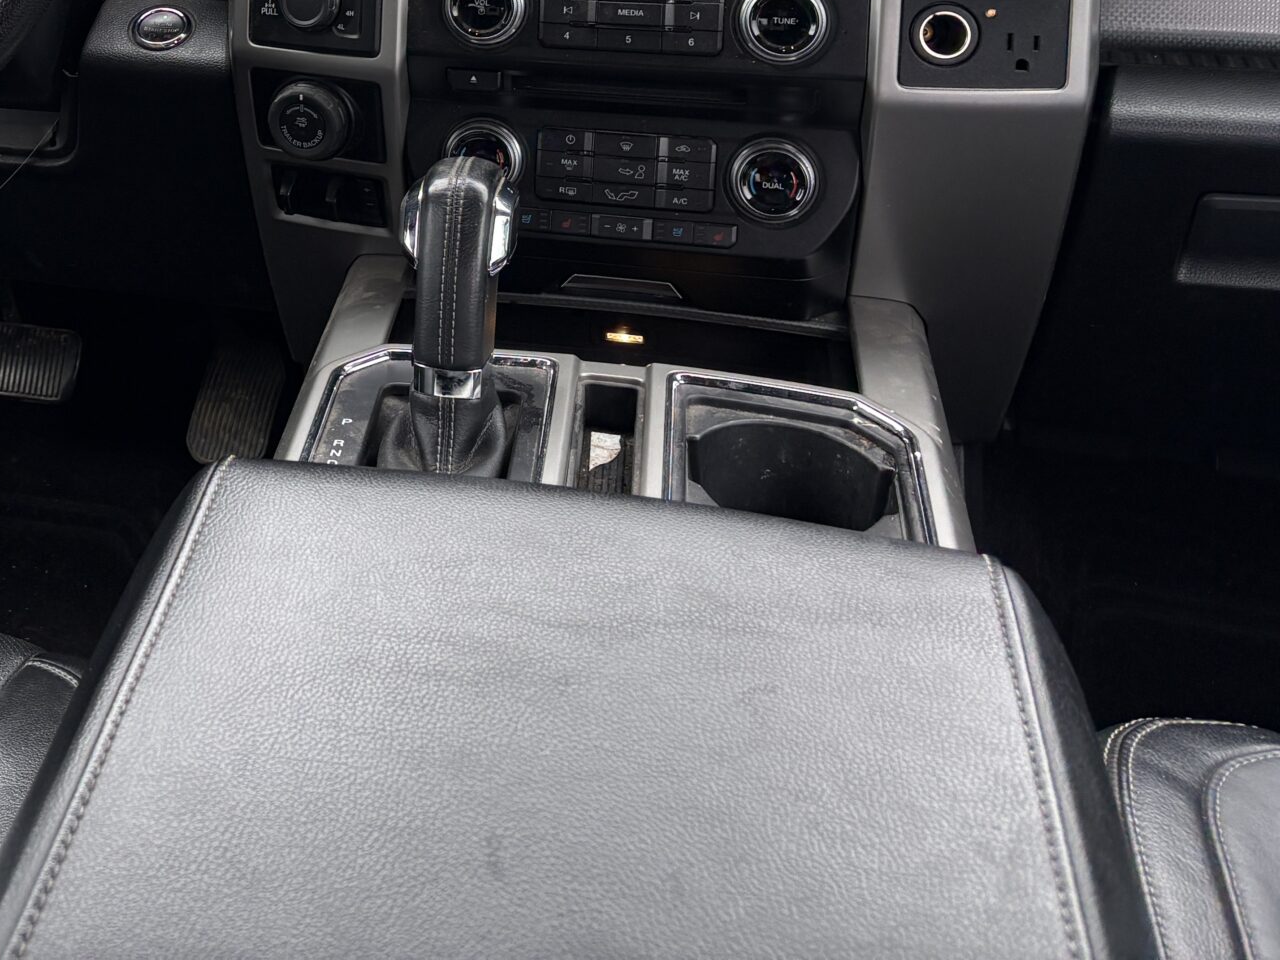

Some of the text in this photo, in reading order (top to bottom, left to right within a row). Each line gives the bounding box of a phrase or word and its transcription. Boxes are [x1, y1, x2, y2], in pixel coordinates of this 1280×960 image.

[261, 7, 279, 16] PULL
[617, 8, 644, 17] MEDIA
[772, 17, 796, 25] TUNE
[563, 31, 570, 40] 4
[625, 35, 632, 44] 5
[688, 38, 695, 46] 6
[281, 124, 324, 148] TRAILER BACKUP
[561, 158, 578, 166] MAX
[673, 168, 690, 176] MAX
[762, 181, 784, 190] DUAL
[672, 197, 688, 205] A/C
[341, 418, 353, 426] P
[333, 439, 345, 447] R
[329, 449, 342, 457] N
